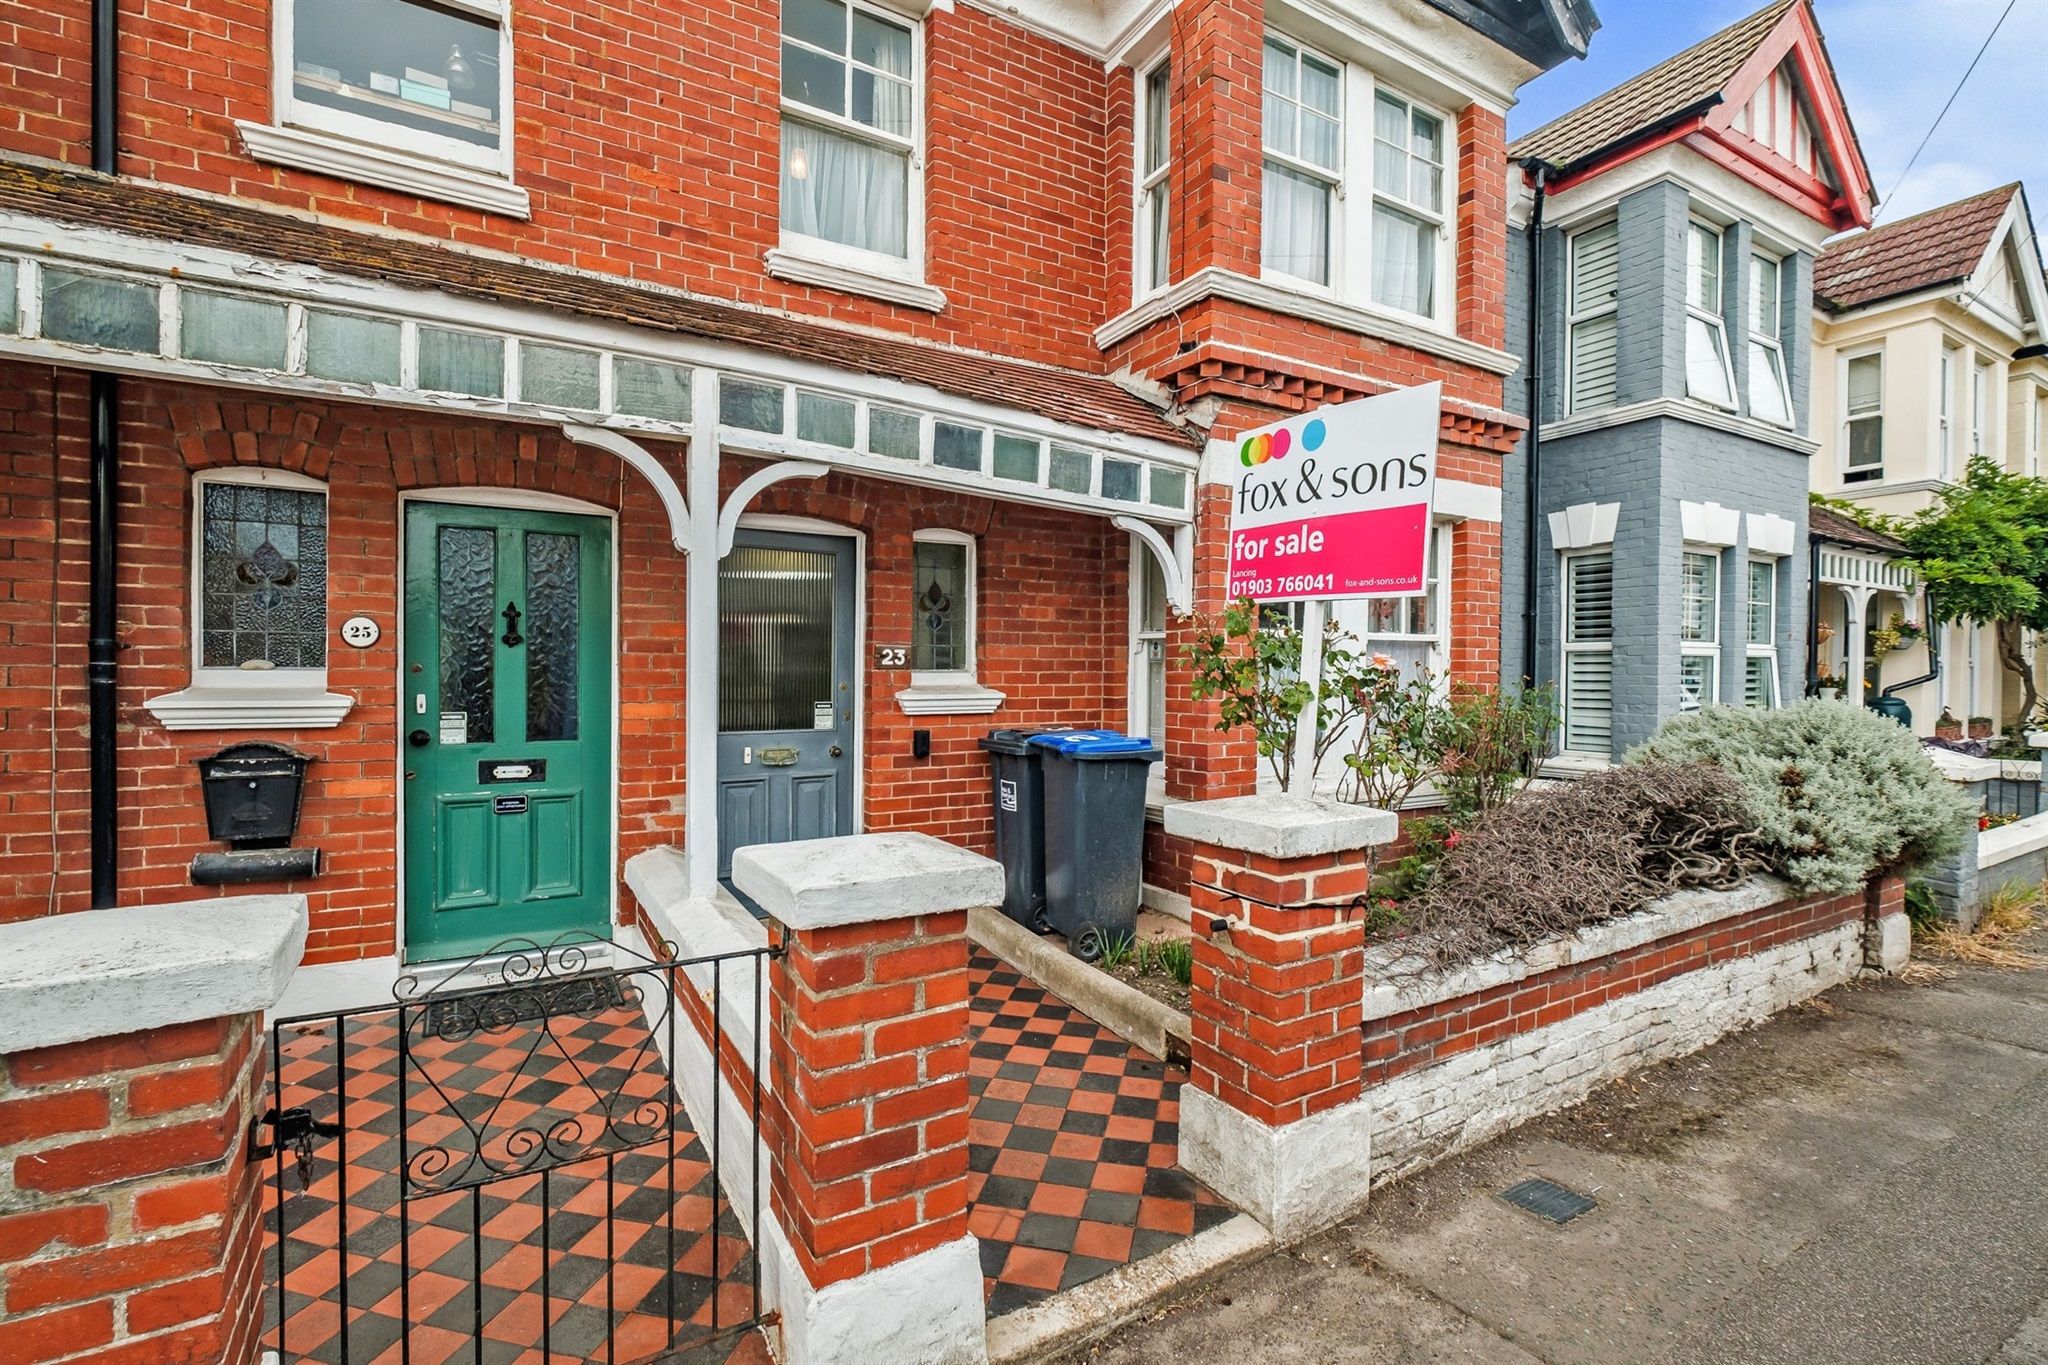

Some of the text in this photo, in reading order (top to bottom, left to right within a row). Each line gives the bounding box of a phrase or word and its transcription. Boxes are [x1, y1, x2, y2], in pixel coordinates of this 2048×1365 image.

[1238, 453, 1427, 514] fox & sons
[1234, 524, 1325, 561] for sale
[1232, 569, 1257, 578] Lancing
[1345, 575, 1418, 587] fox-and-sons.co.uk
[1232, 573, 1334, 596] 01903 766041
[350, 626, 371, 638] 25
[881, 649, 906, 665] 23
